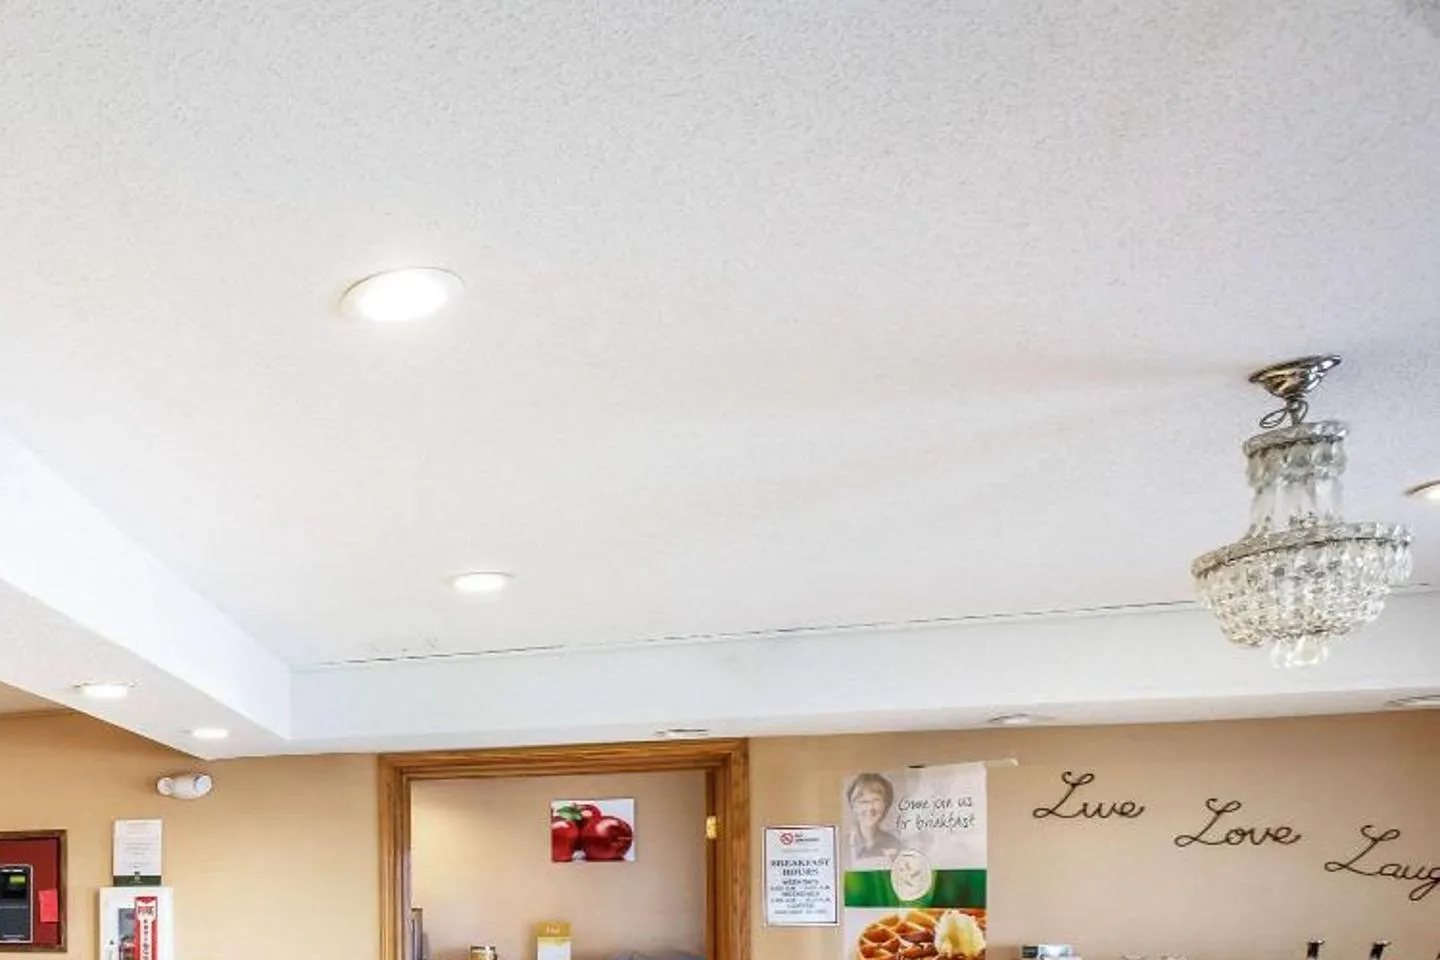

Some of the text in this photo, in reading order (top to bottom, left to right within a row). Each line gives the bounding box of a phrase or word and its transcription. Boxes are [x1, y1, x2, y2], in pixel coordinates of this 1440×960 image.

[1033, 771, 1145, 819] Live
[1174, 798, 1303, 848] Love
[1324, 824, 1440, 901] Laug
